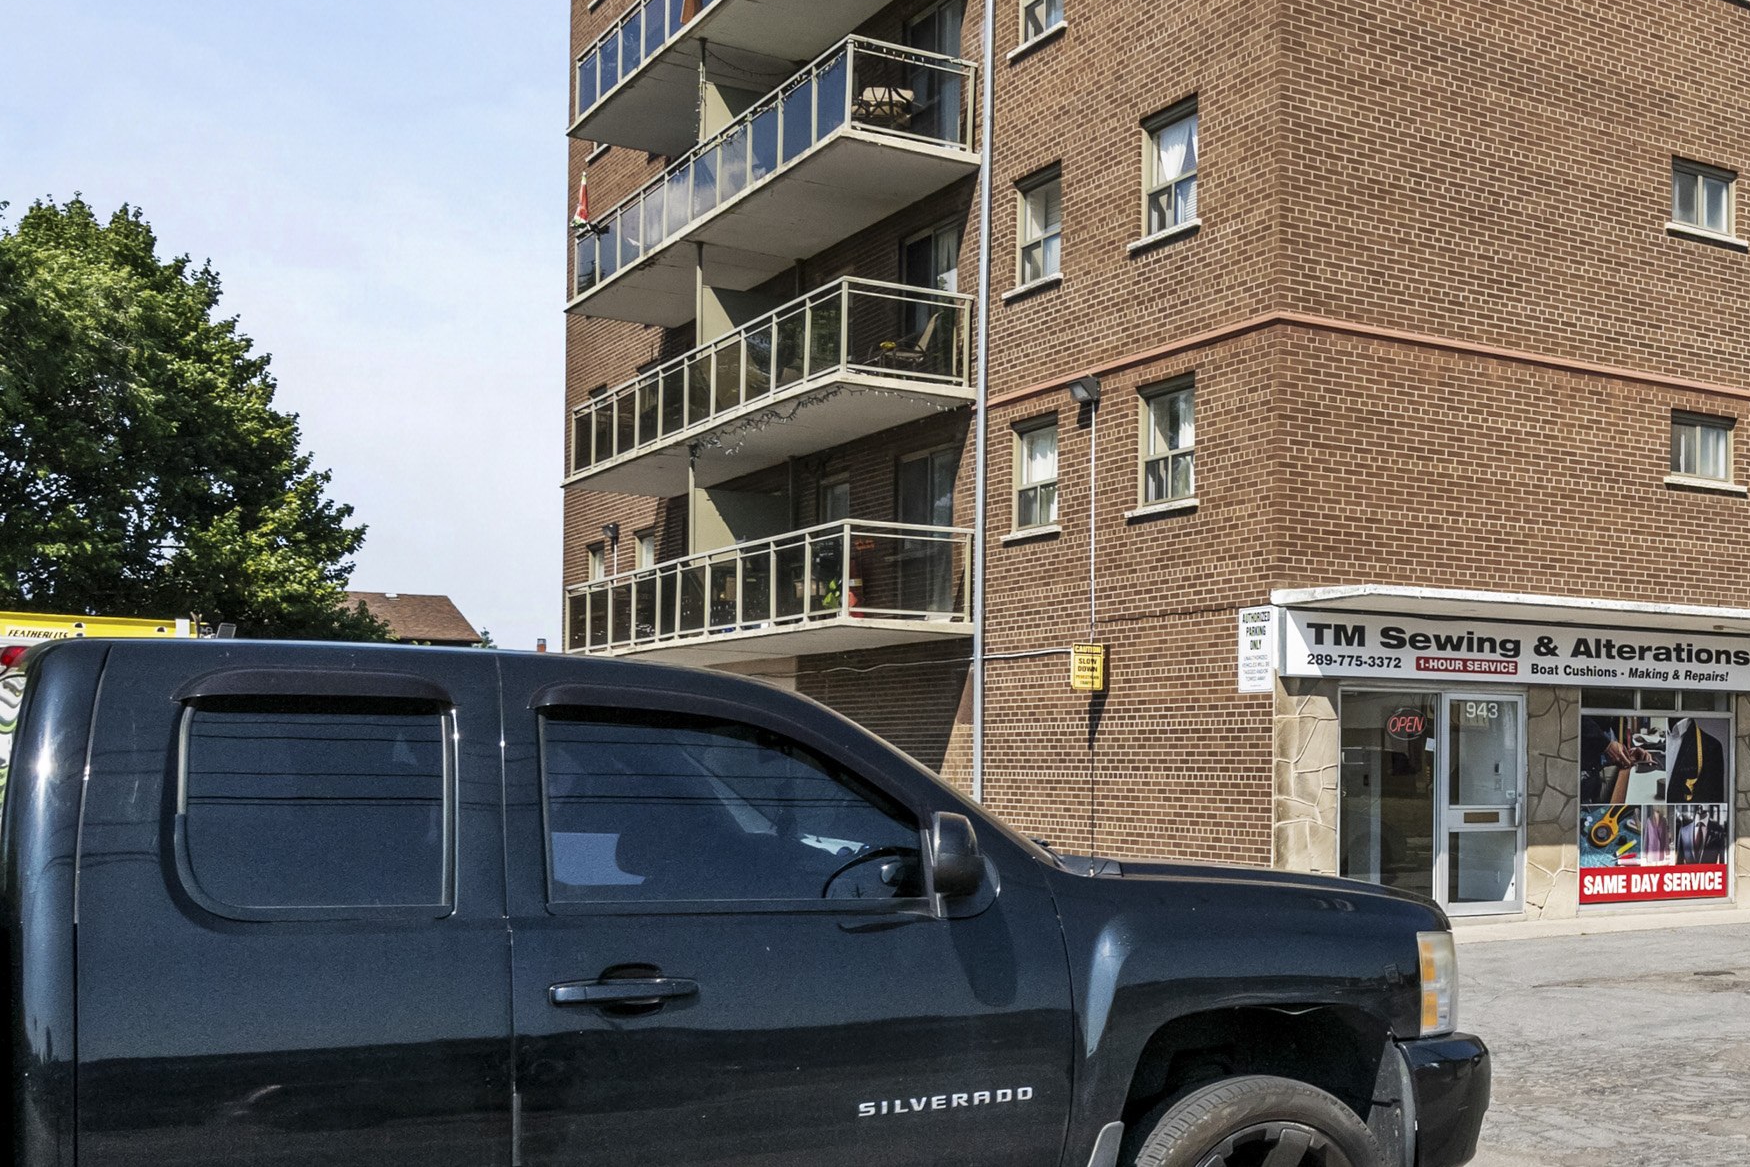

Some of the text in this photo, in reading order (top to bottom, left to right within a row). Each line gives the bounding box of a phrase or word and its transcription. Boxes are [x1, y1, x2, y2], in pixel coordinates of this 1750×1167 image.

[1242, 611, 1271, 624] AUTHORIZED
[1246, 625, 1266, 637] PARKING
[1250, 640, 1262, 650] ONLY
[1306, 622, 1366, 647] TM
[1379, 626, 1522, 659] Sewing
[1533, 635, 1560, 657] &
[1307, 653, 1516, 673] 289-775-3372 1-HOUR SERVICE
[1531, 663, 1559, 676] Boat
[1563, 664, 1618, 678] Cushions
[1628, 667, 1669, 682] Making
[1672, 670, 1681, 680] &
[1684, 670, 1729, 683] Repairs!
[1466, 702, 1499, 719] 943
[1389, 716, 1425, 733] OPEN
[1583, 871, 1723, 895] SAME DAY SERVICE
[858, 1086, 1033, 1117] SILVERADO
